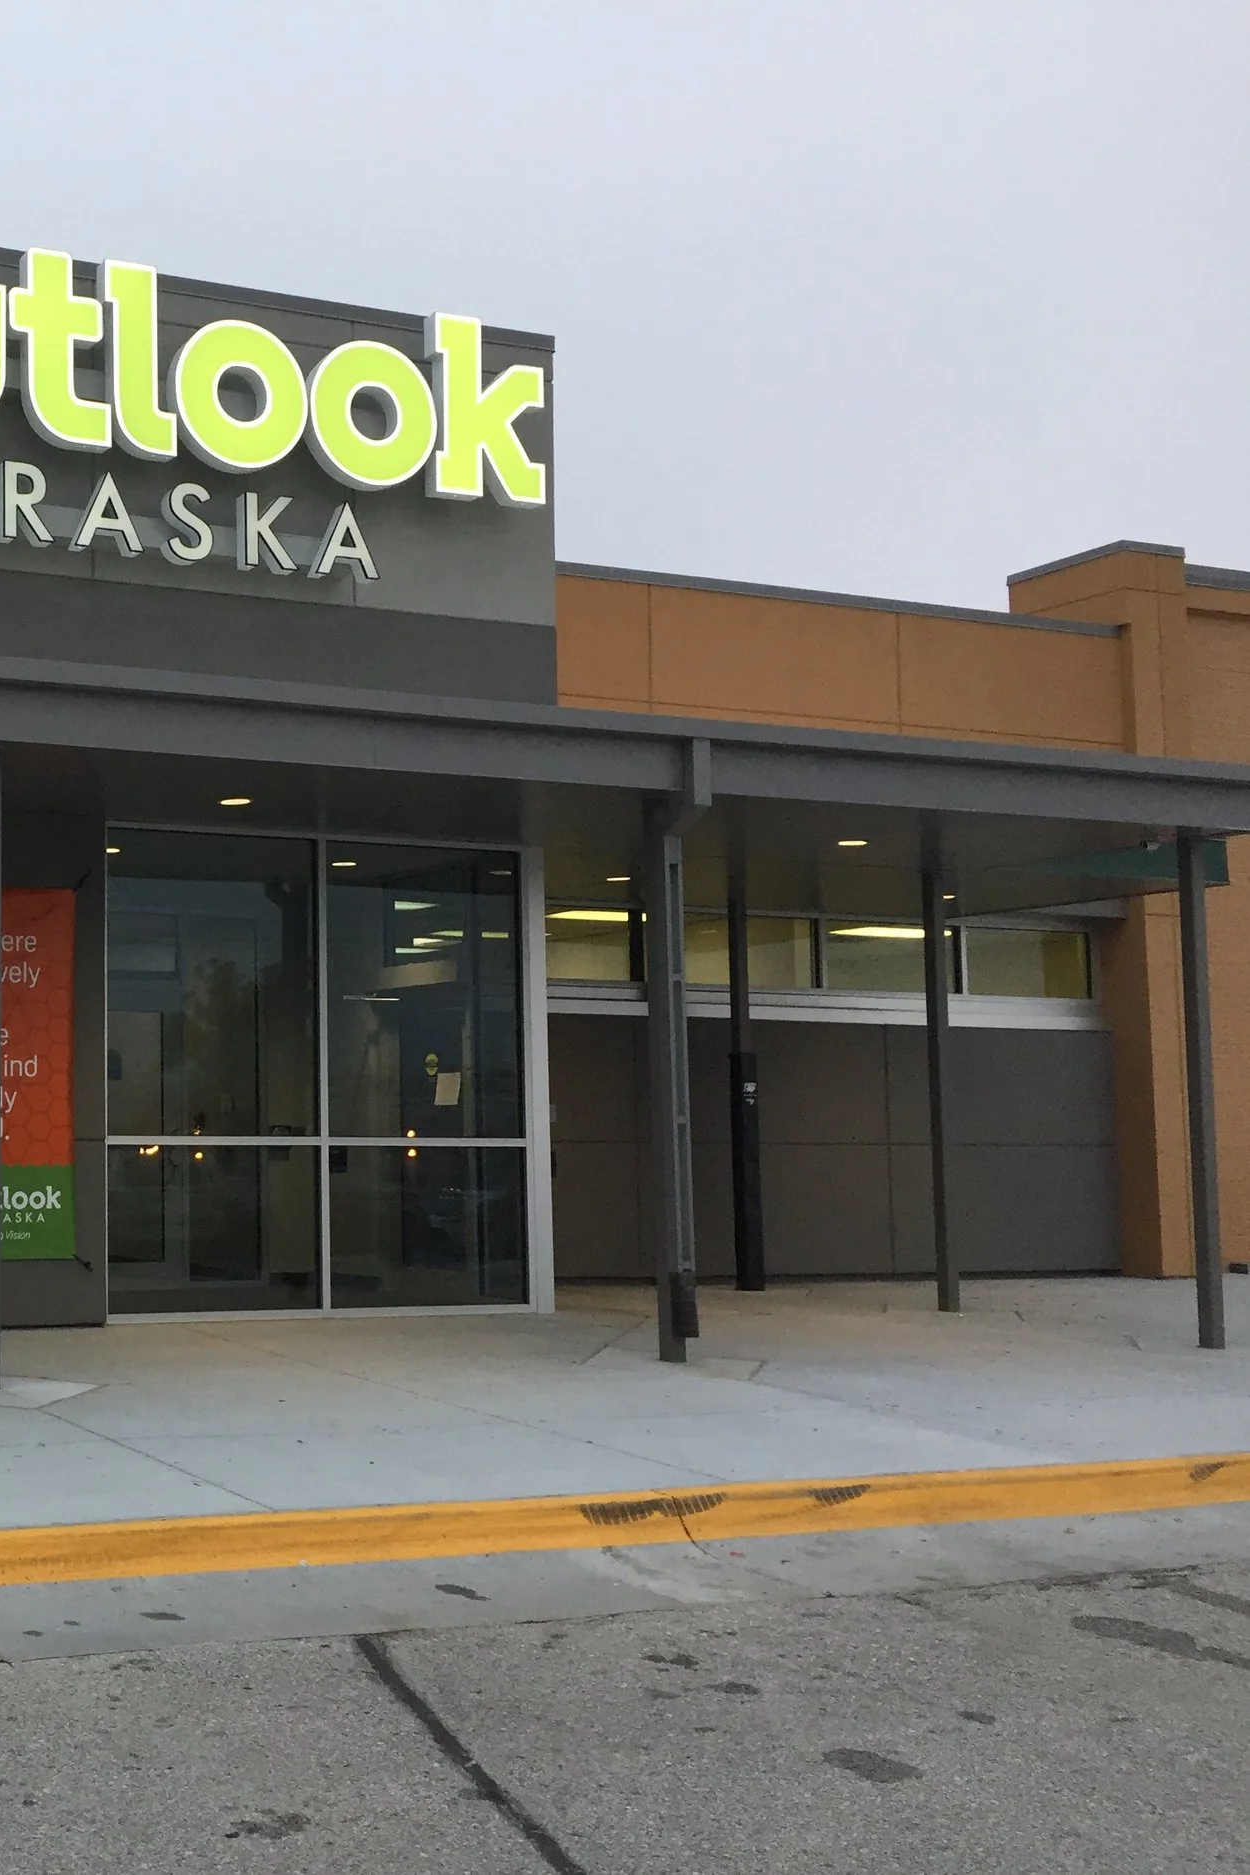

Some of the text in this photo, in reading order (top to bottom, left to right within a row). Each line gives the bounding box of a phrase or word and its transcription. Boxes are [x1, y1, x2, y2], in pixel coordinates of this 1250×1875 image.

[1, 934, 37, 953] ere
[3, 1054, 38, 1078] ind
[5, 1230, 31, 1241] Vision
